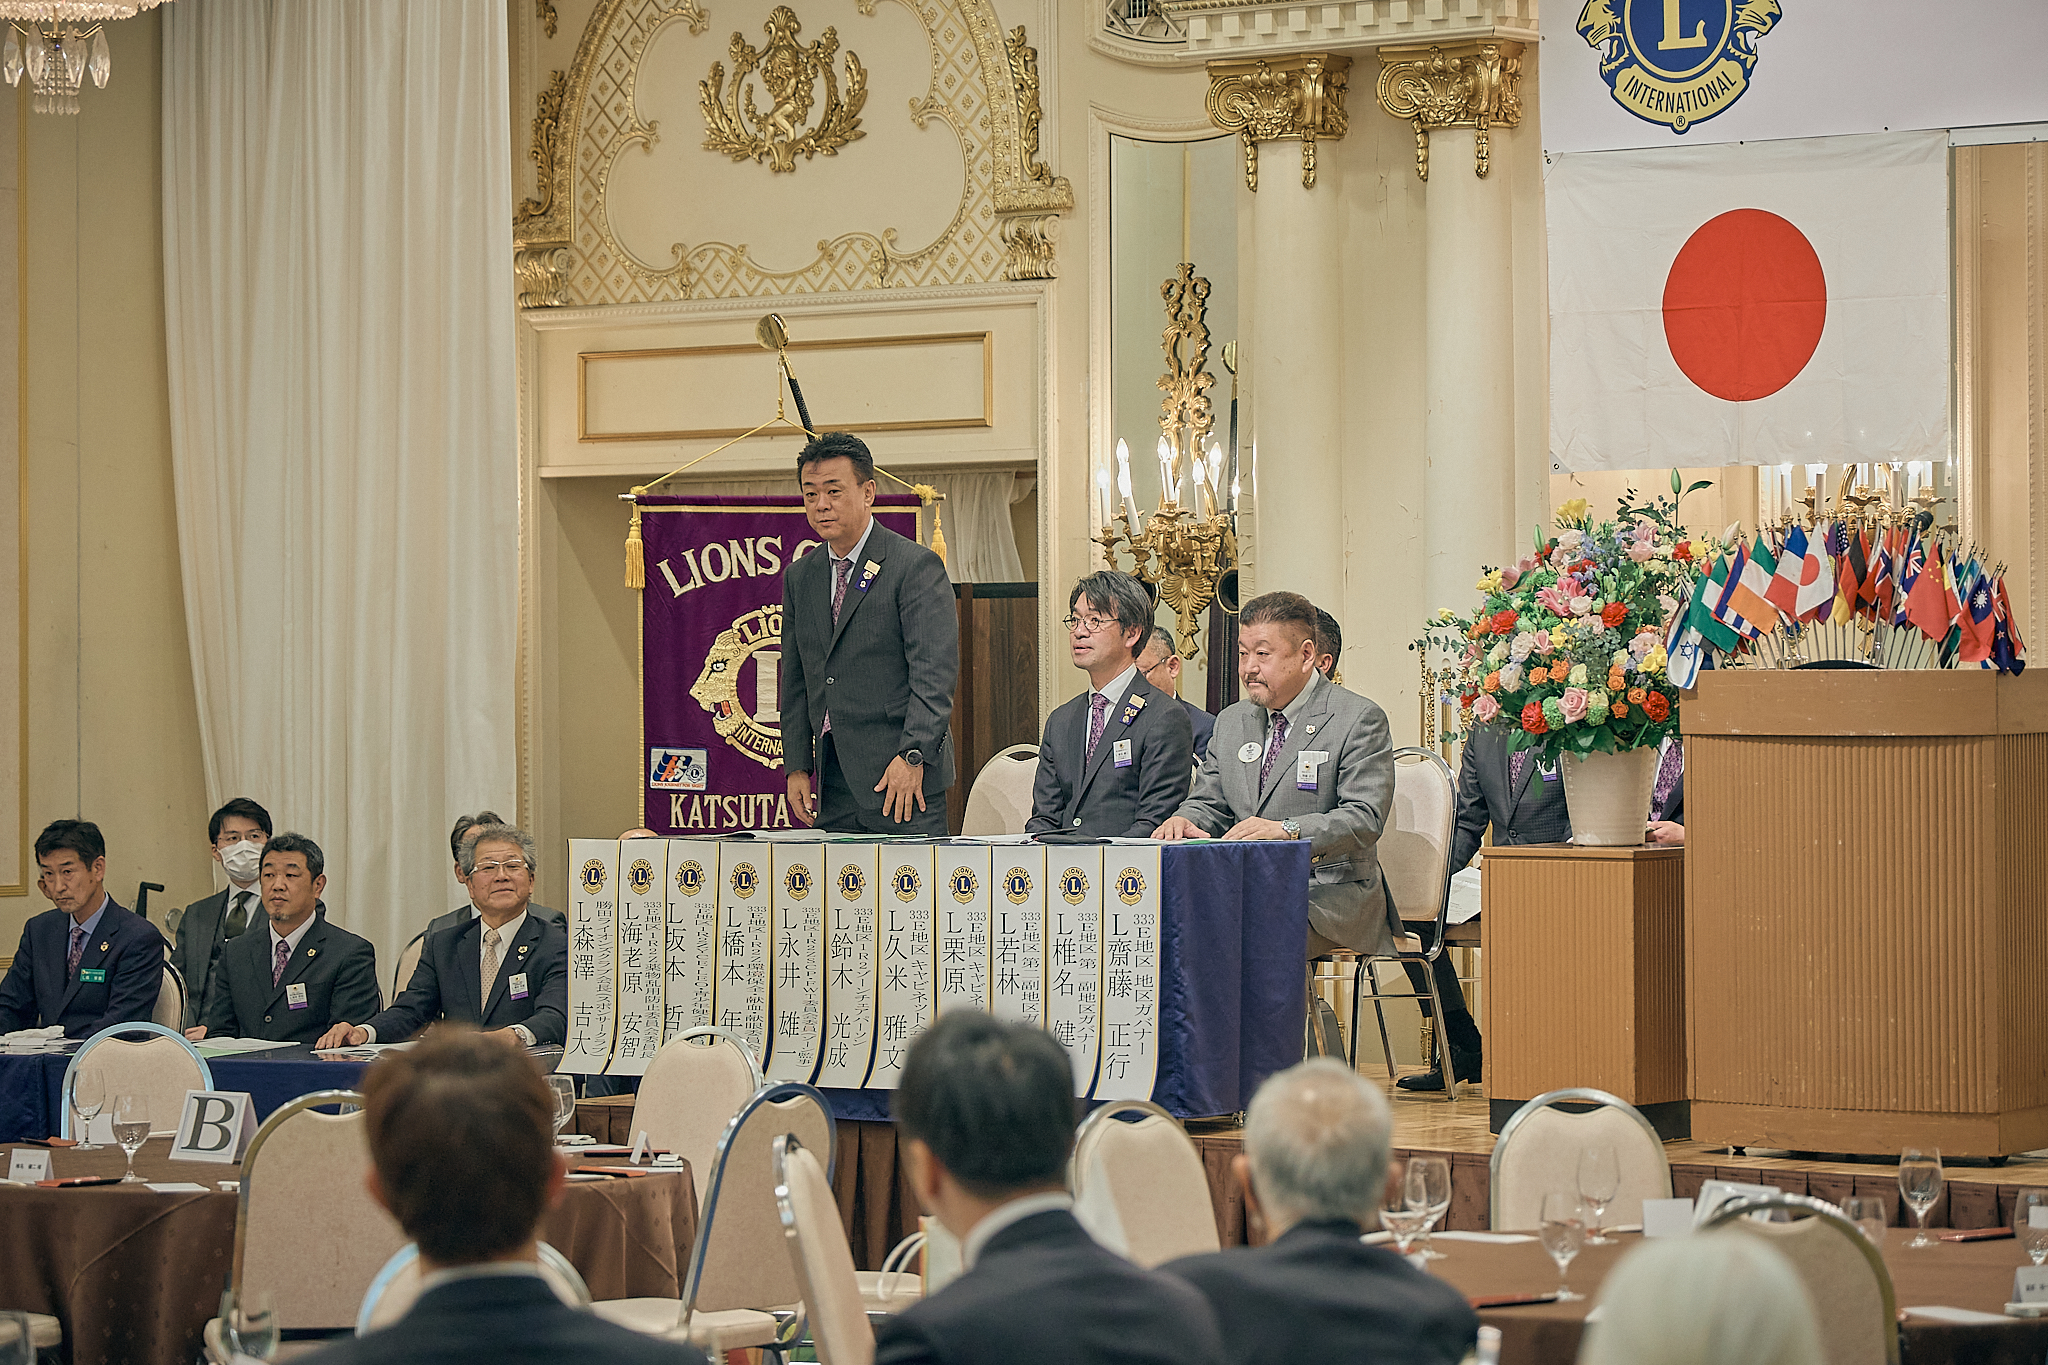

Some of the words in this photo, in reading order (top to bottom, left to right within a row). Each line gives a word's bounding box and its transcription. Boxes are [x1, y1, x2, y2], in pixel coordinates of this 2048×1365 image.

[1657, 0, 1708, 51] L
[1622, 70, 1737, 114] INTERNATIONAL
[656, 535, 782, 599] LIONS
[740, 614, 783, 644] LIO
[735, 724, 784, 756] INTERNA
[669, 793, 793, 829] KATSUTA
[590, 870, 598, 883] L
[638, 870, 646, 883] L
[687, 871, 695, 885] L
[741, 873, 749, 887] L
[795, 875, 803, 888] L
[848, 875, 856, 889] L
[903, 876, 911, 890] L
[960, 878, 969, 892] L
[1014, 878, 1023, 892] L
[1070, 878, 1080, 892] L
[1127, 879, 1136, 893] L
[572, 901, 595, 981] L森澤
[621, 902, 643, 994] L海老原
[721, 906, 745, 987] L橋本
[778, 907, 801, 989] L永井
[830, 908, 854, 990] L鈴木
[884, 910, 908, 992] L久米
[942, 911, 966, 994] L栗原
[995, 912, 1020, 996] L若林
[1052, 913, 1078, 997] L椎名
[1021, 956, 1040, 1025] 第二副地区ガ
[569, 1001, 593, 1056] 吉大
[620, 1012, 643, 1059] 安智
[664, 1004, 684, 1040] 哲
[720, 1008, 743, 1042] 年
[777, 1010, 800, 1055] 雄一
[1053, 1019, 1077, 1053] 健
[1133, 974, 1154, 1056] 地区ガバナー
[825, 1012, 851, 1069] 光成
[879, 1014, 907, 1071] 雅文
[1105, 1022, 1132, 1081] 正行
[180, 1096, 235, 1152] B
